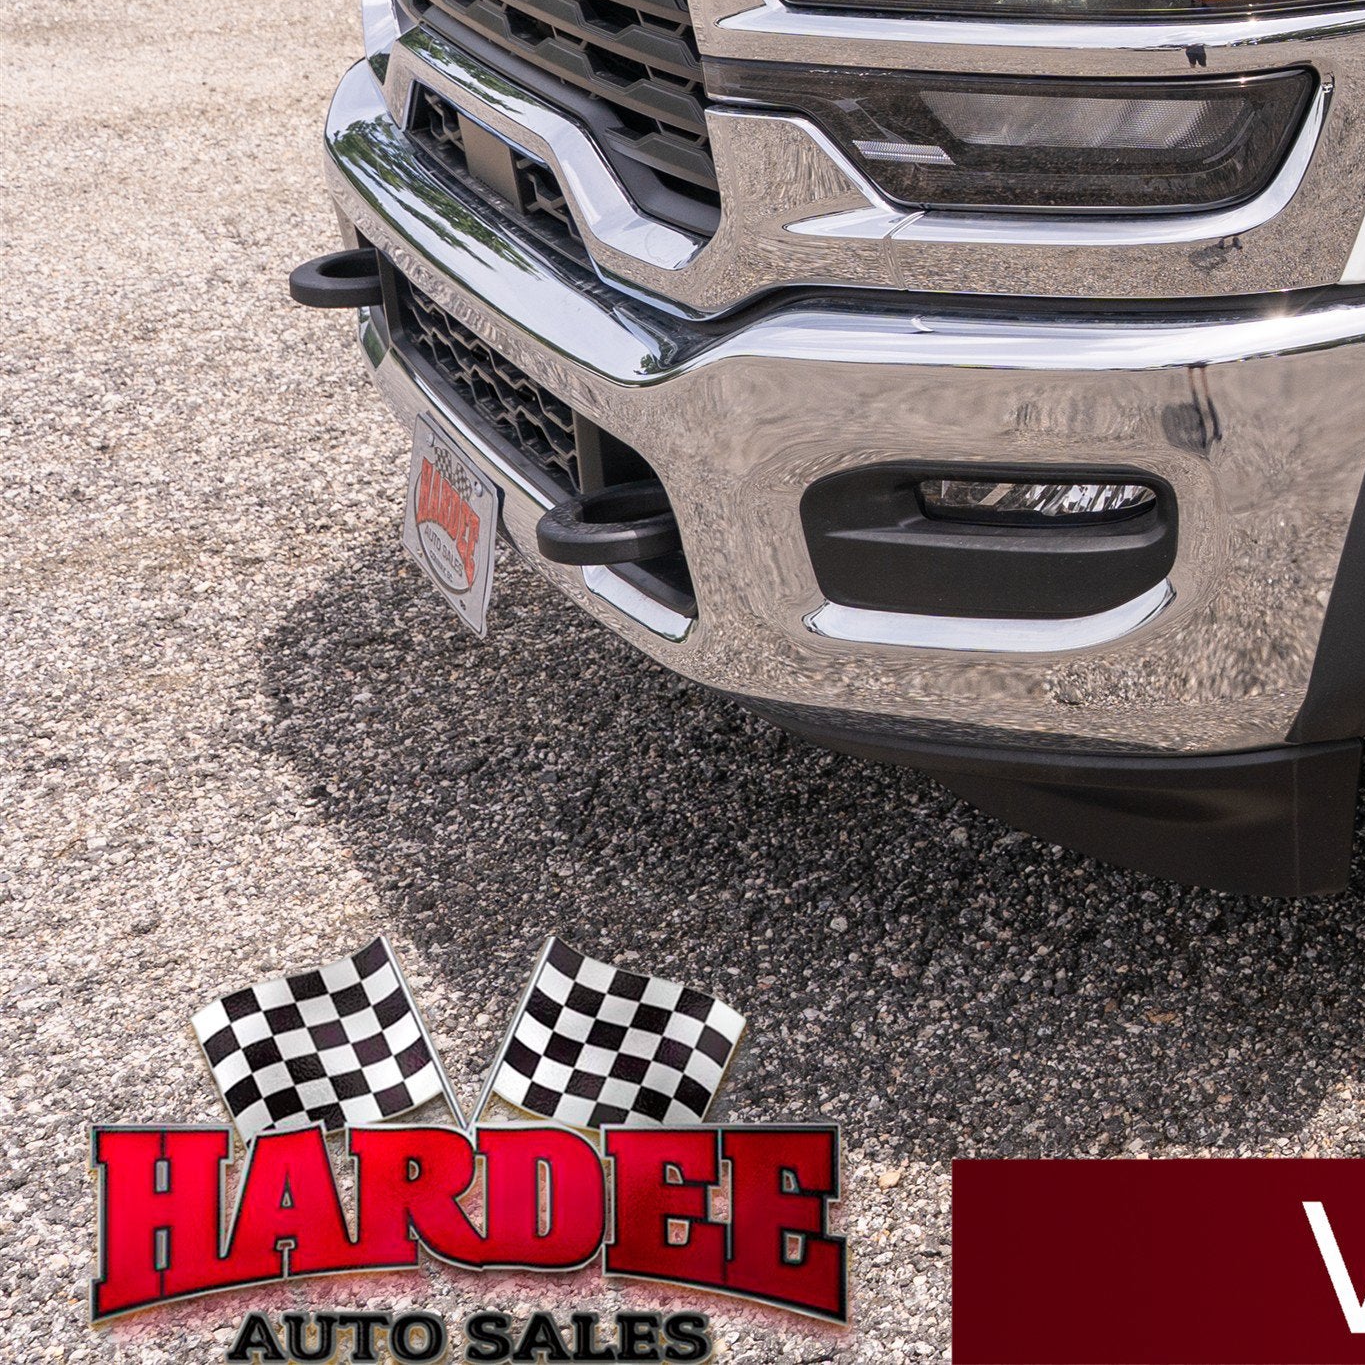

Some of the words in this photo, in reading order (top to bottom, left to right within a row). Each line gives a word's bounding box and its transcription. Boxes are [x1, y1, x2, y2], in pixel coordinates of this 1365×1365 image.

[416, 456, 480, 589] HARDEE
[424, 524, 442, 552] AUTO
[442, 544, 463, 578] SALES
